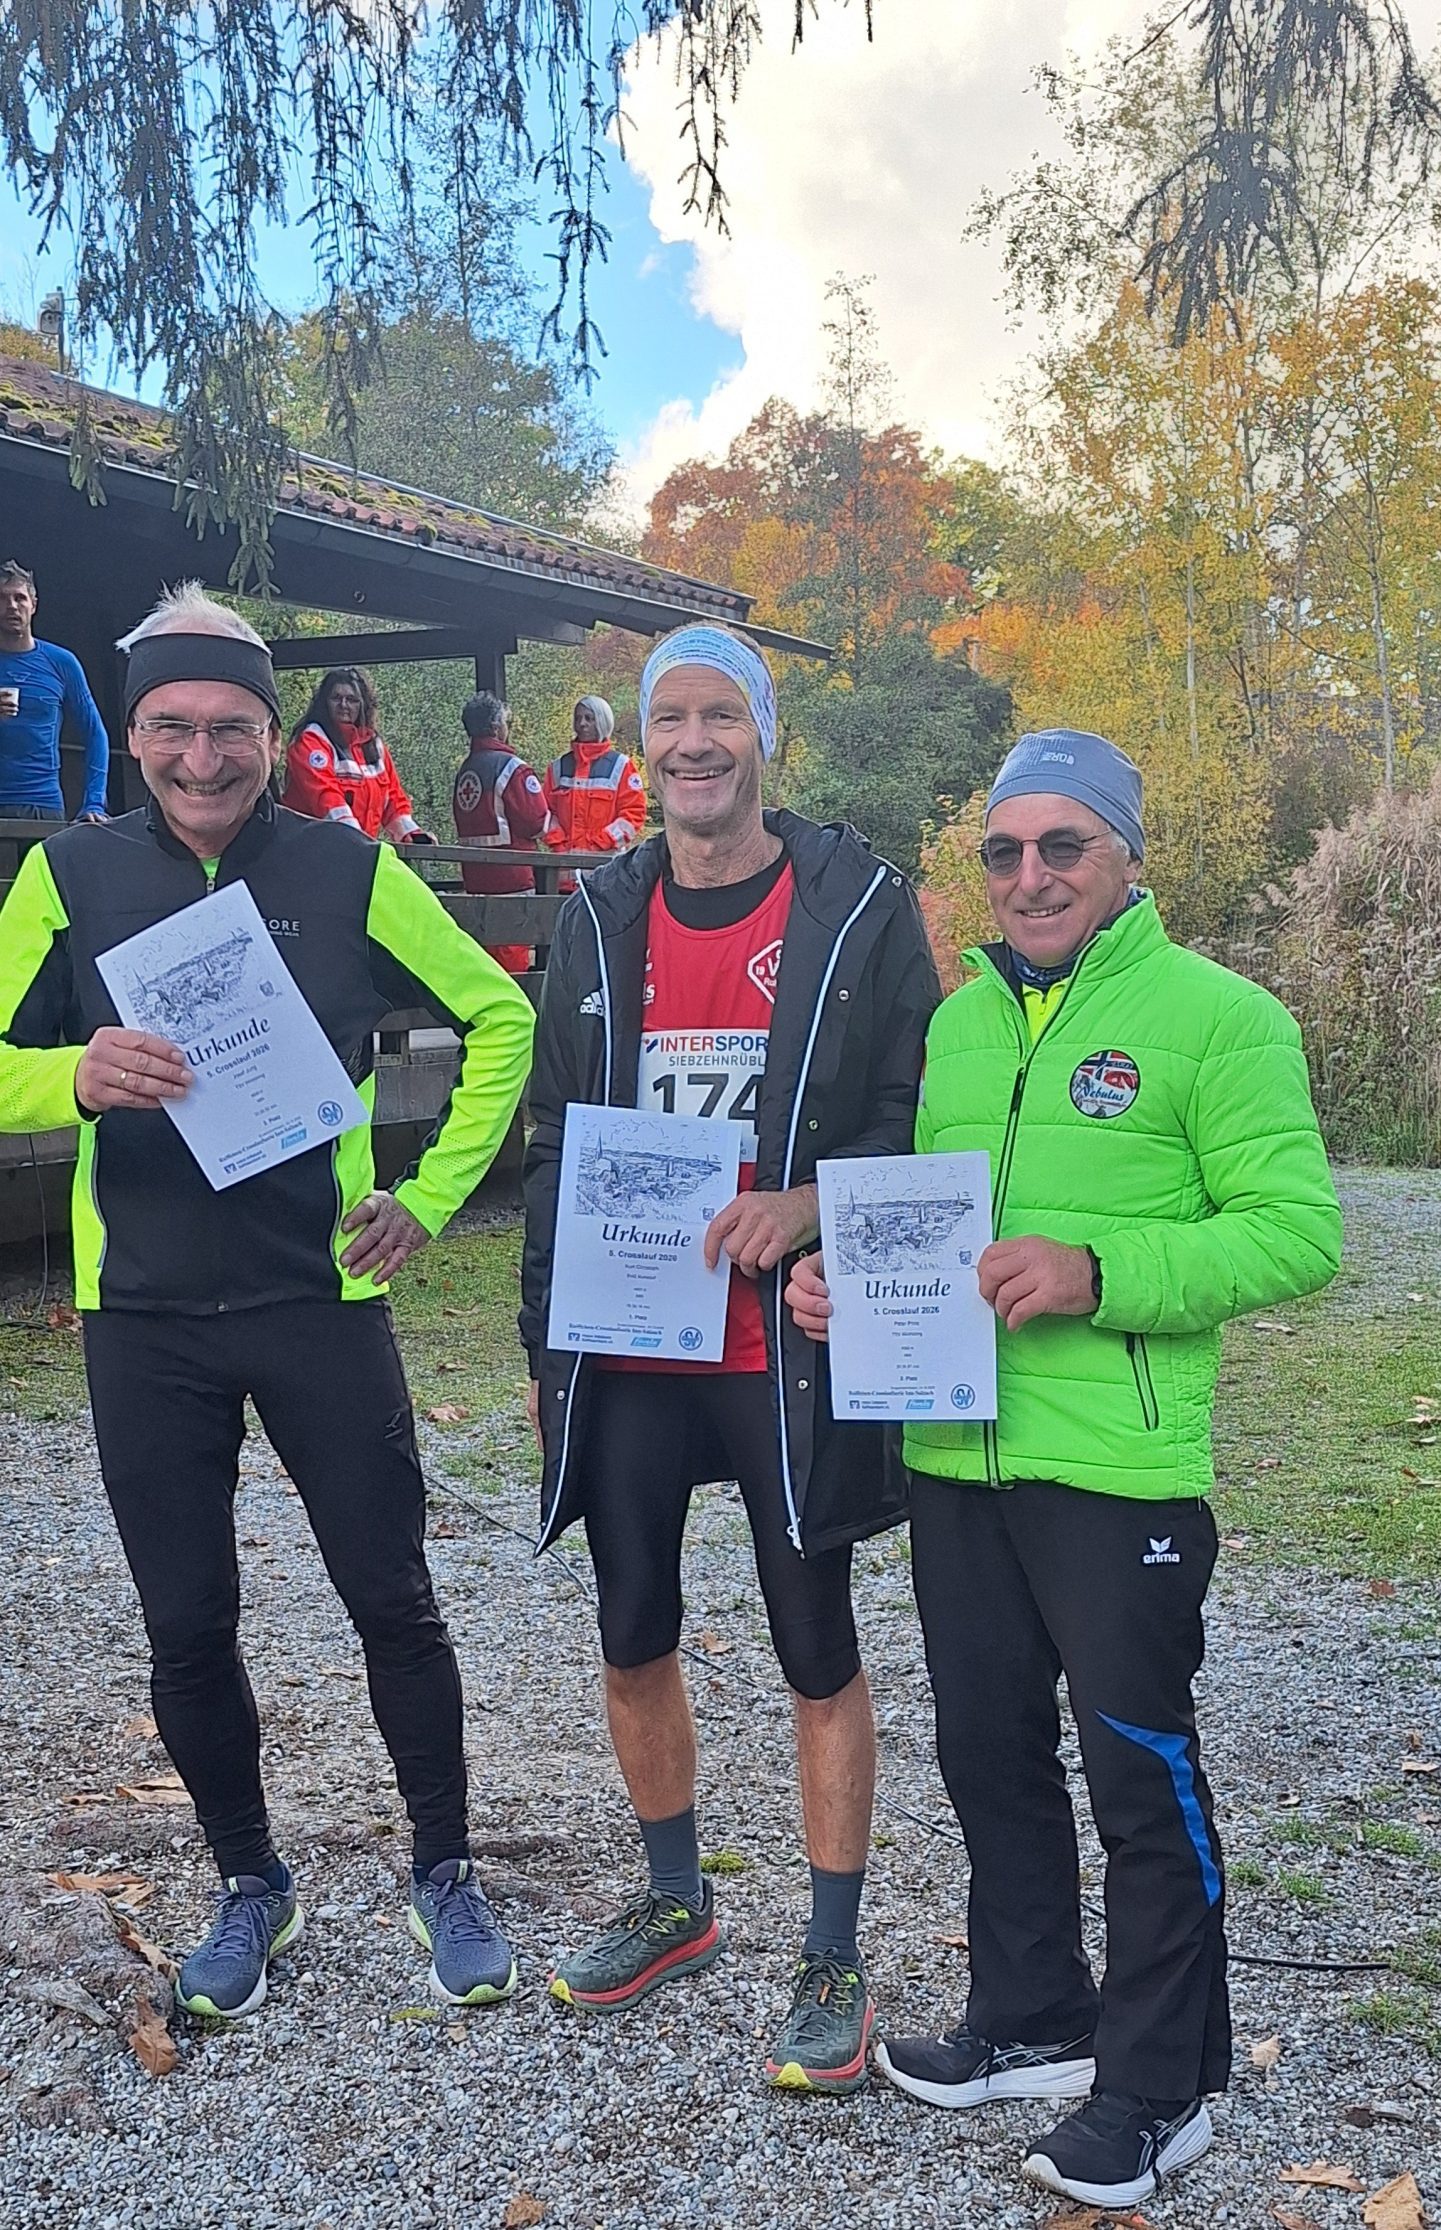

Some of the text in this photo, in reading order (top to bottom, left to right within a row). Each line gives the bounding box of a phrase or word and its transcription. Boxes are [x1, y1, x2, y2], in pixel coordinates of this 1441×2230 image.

[262, 918, 301, 932] ORE
[185, 1017, 271, 1066] Urkunde
[660, 1035, 769, 1052] INTERSPOR
[215, 1051, 252, 1075] Crosslauf
[1075, 1085, 1125, 1101] Nebulus
[602, 1223, 692, 1248] Urkunde
[618, 1250, 657, 1260] Crosslauf
[865, 1278, 951, 1300] Urkunde
[882, 1307, 919, 1316] Crosslauf
[921, 1306, 940, 1314] 2026
[1143, 1553, 1181, 1564] erima
